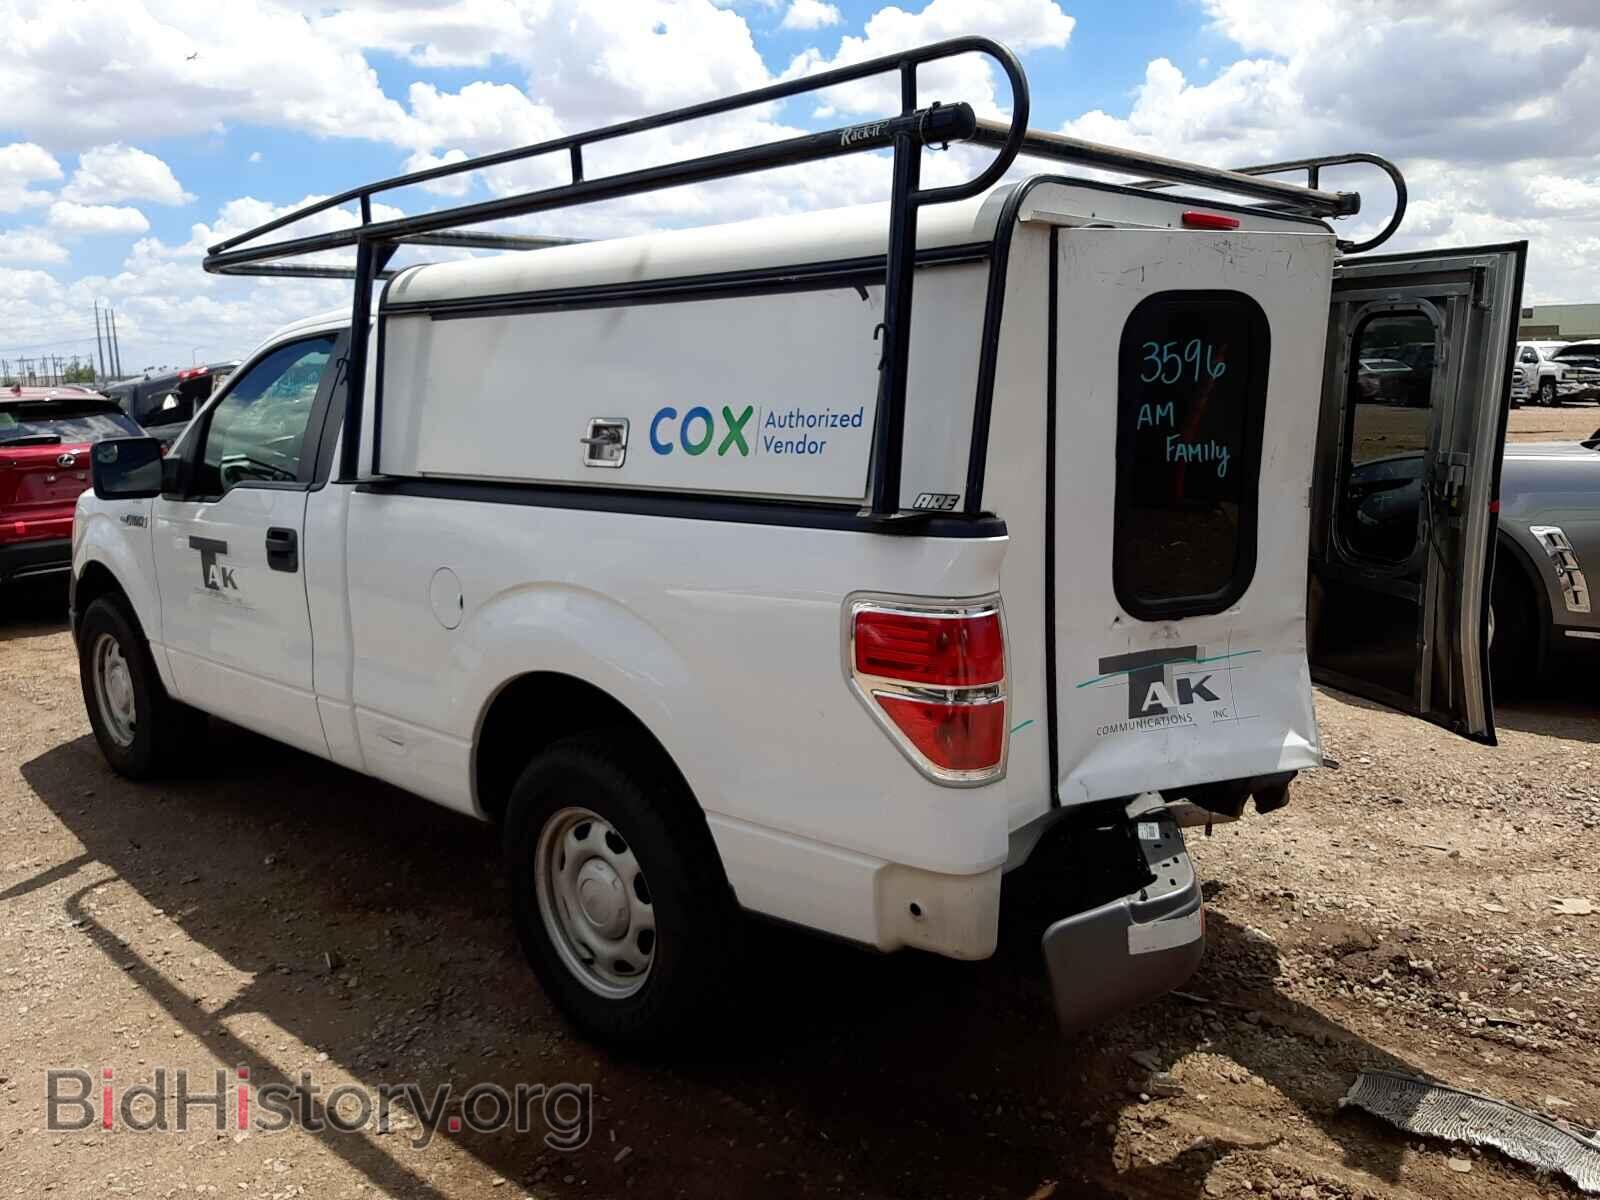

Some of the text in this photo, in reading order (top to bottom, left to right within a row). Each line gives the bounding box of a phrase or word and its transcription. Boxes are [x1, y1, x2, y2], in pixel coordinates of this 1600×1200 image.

[1140, 338, 1227, 384] 3596
[765, 407, 864, 429] Authorized
[1136, 401, 1175, 430] AM
[649, 405, 754, 456] COX
[764, 435, 827, 455] Vendor
[912, 493, 960, 510] ARE
[1096, 707, 1229, 736] COMMUNICATIONS INC
